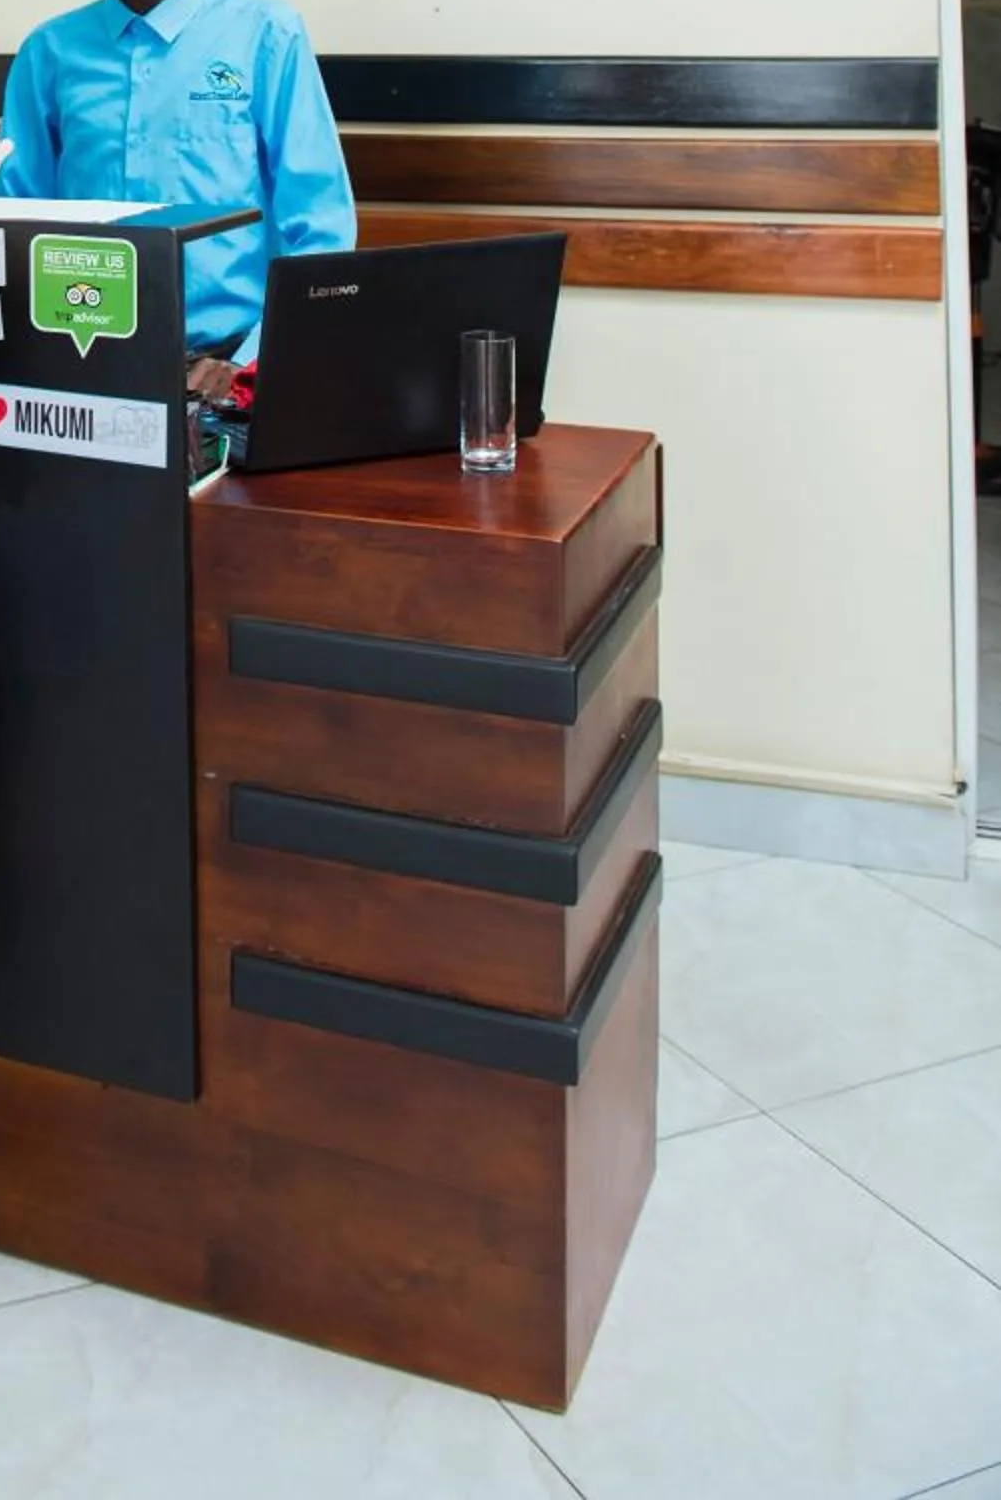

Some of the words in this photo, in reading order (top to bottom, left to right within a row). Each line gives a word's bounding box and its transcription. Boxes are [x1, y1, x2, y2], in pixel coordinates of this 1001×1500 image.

[44, 251, 100, 267] REVIEW
[105, 254, 125, 269] US
[309, 283, 359, 298] Lenovo
[14, 399, 94, 442] MIKUMI
